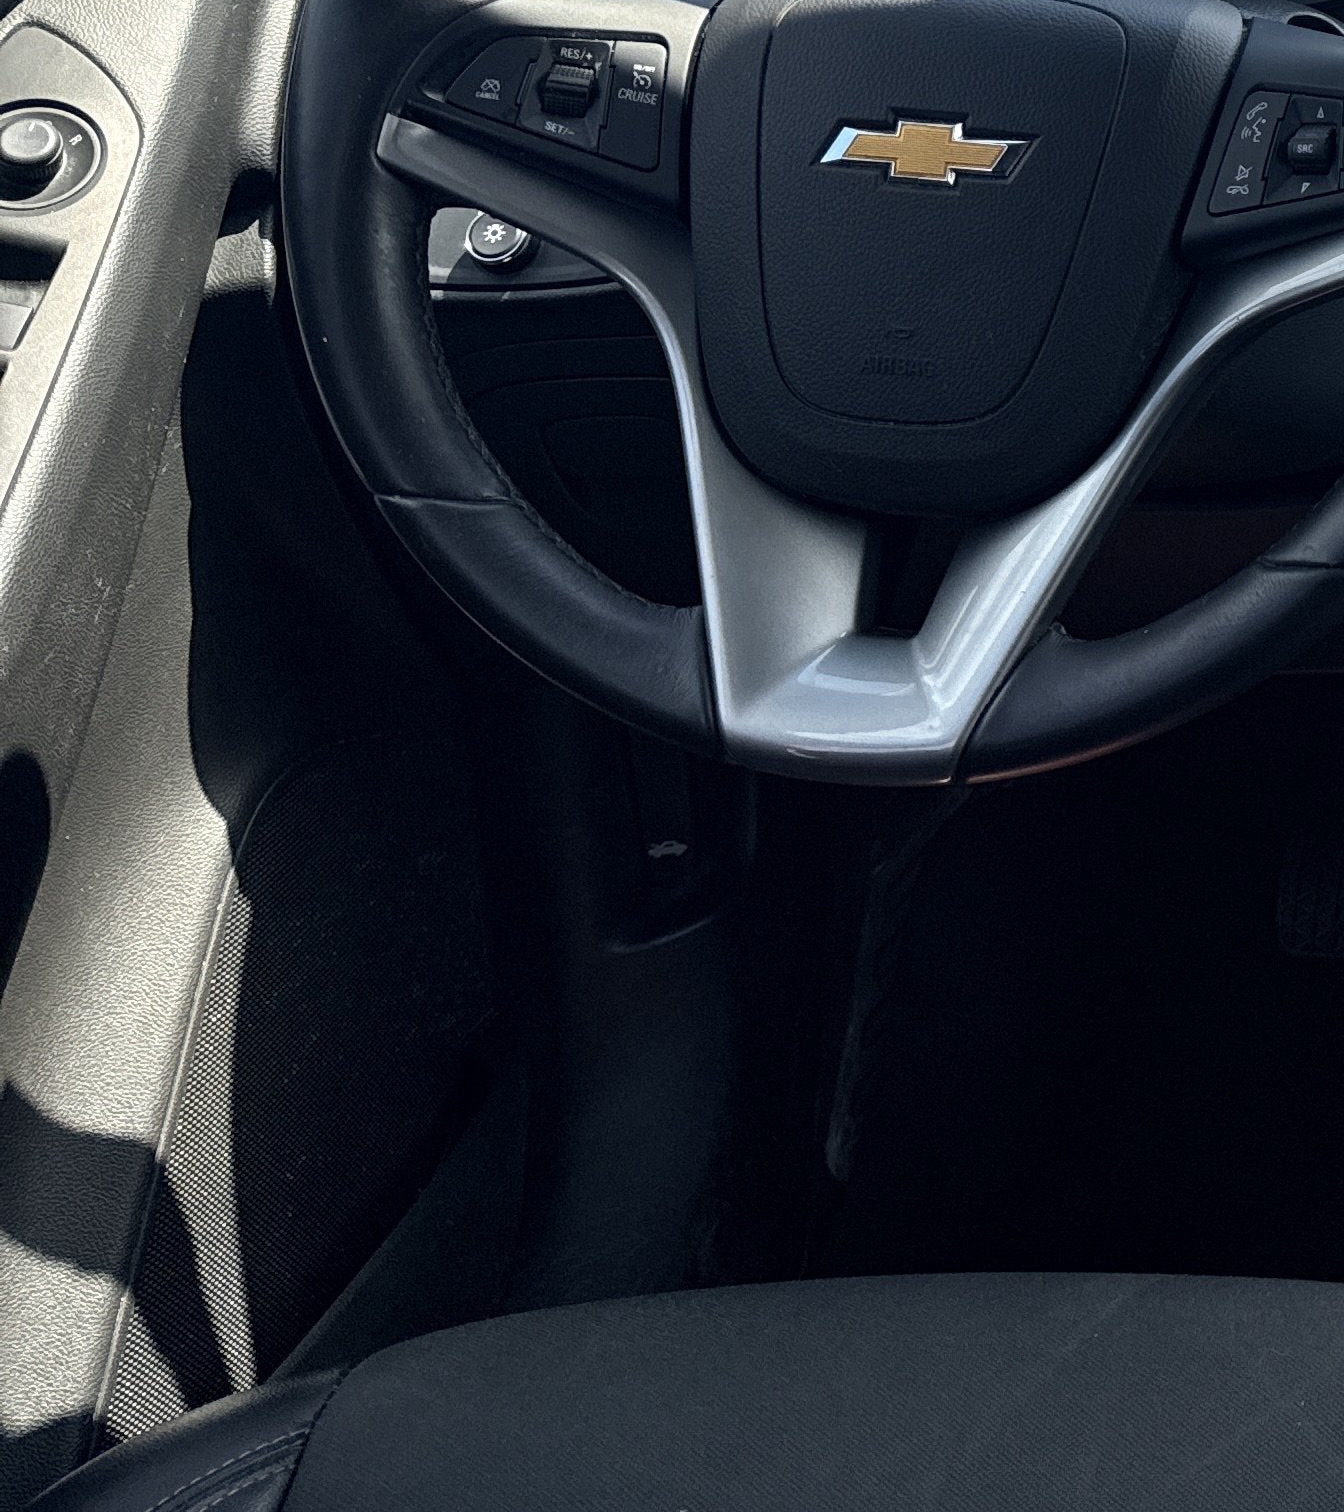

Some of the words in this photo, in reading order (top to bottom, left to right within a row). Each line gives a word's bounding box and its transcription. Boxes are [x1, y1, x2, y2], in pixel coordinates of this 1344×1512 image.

[617, 88, 658, 105] CRUISE
[1297, 144, 1313, 153] SRC
[861, 354, 937, 378] AIRBAG
